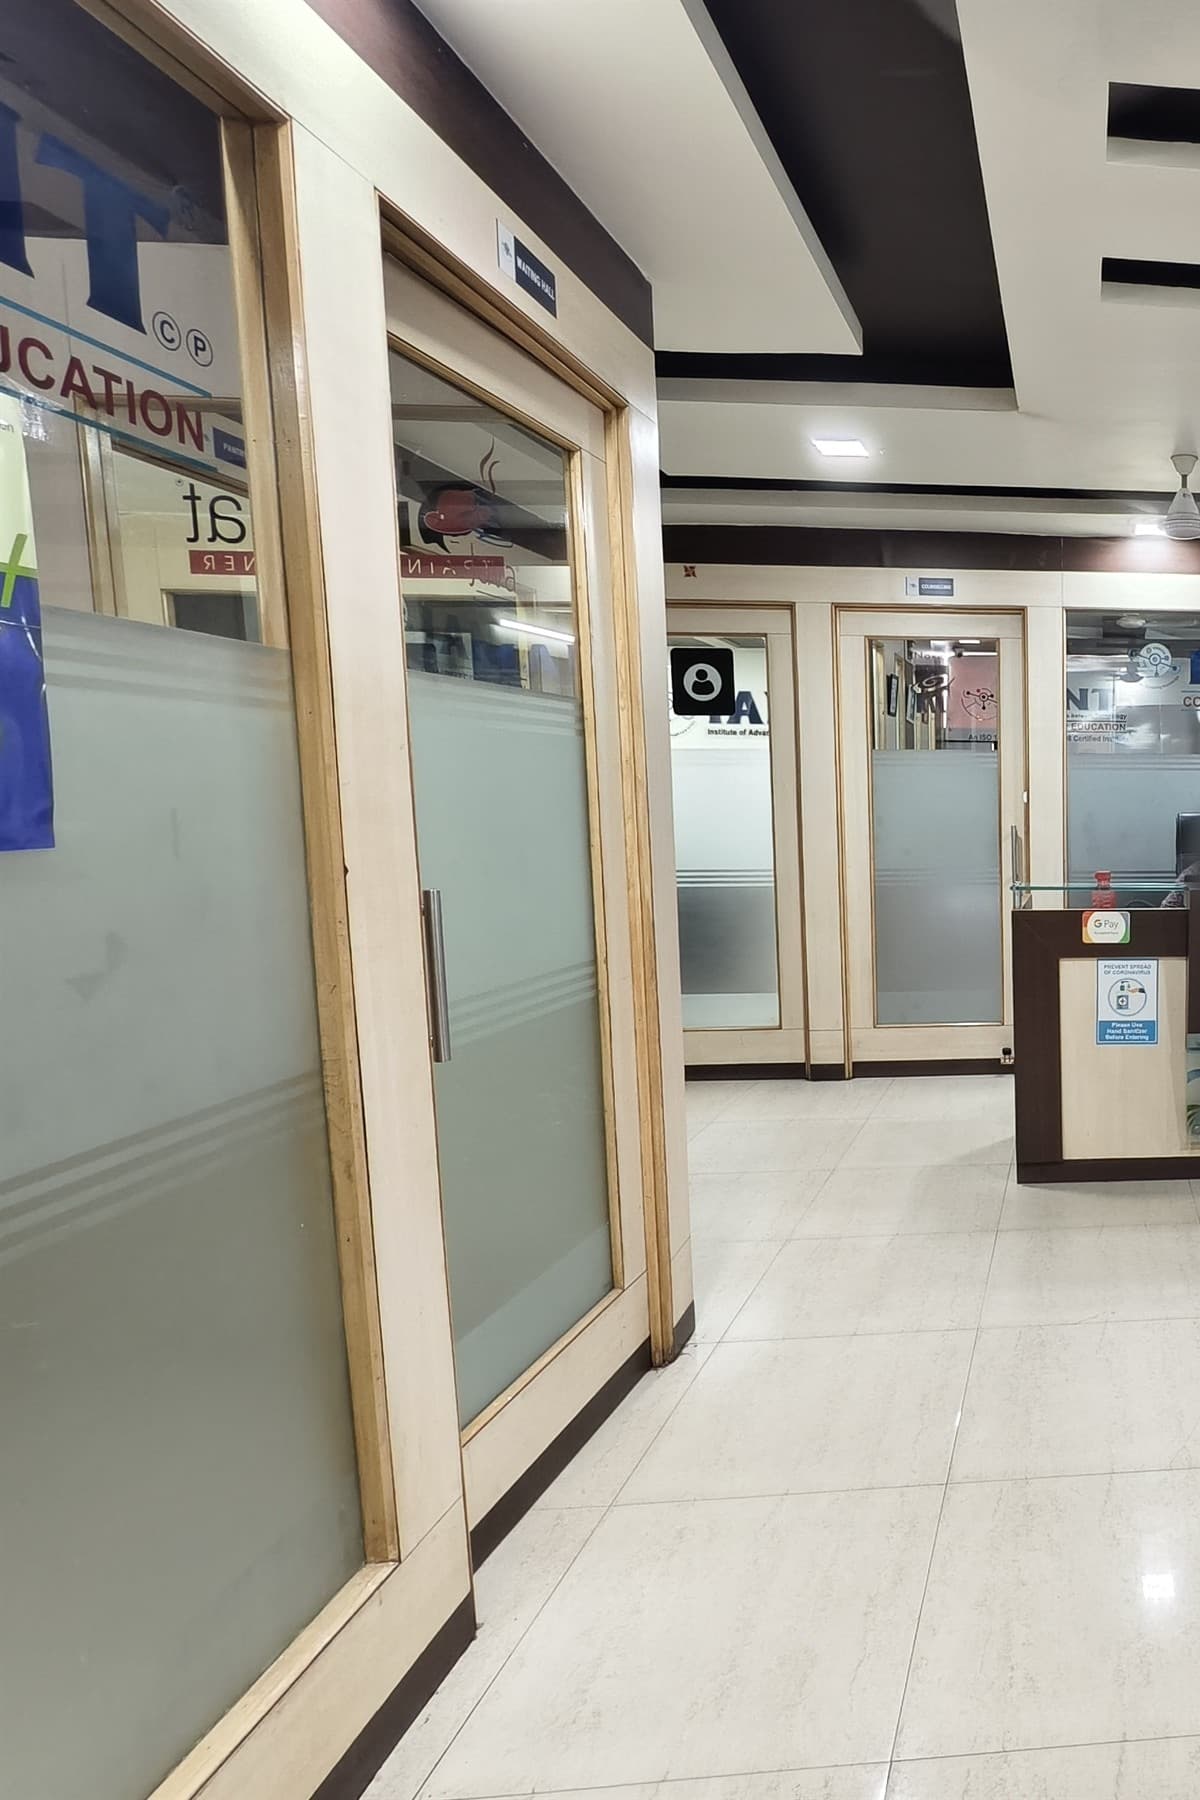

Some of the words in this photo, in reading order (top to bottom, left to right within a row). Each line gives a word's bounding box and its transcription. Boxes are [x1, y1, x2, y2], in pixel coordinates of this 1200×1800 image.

[516, 255, 541, 287] WAITING
[541, 279, 555, 301] HALL
[1103, 919, 1120, 930] Pay
